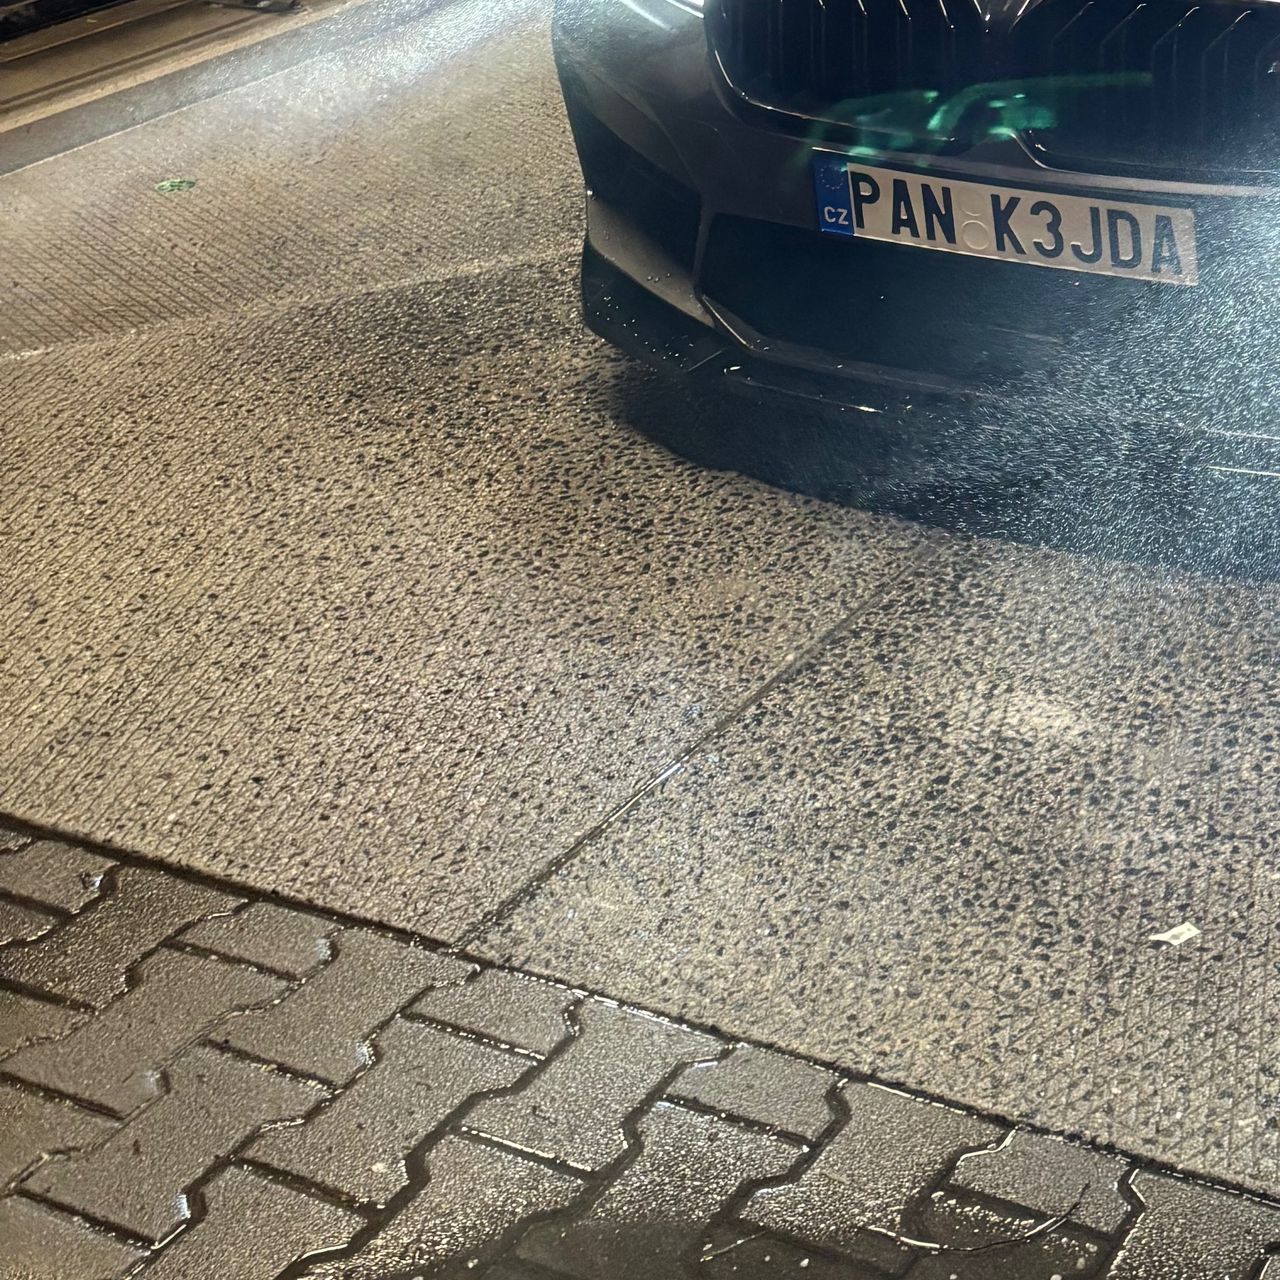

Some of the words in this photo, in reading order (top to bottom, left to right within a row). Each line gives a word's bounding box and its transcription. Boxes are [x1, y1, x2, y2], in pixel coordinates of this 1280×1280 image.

[823, 206, 849, 225] CZ
[850, 171, 957, 245] PAN
[990, 193, 1184, 276] K3JDA
